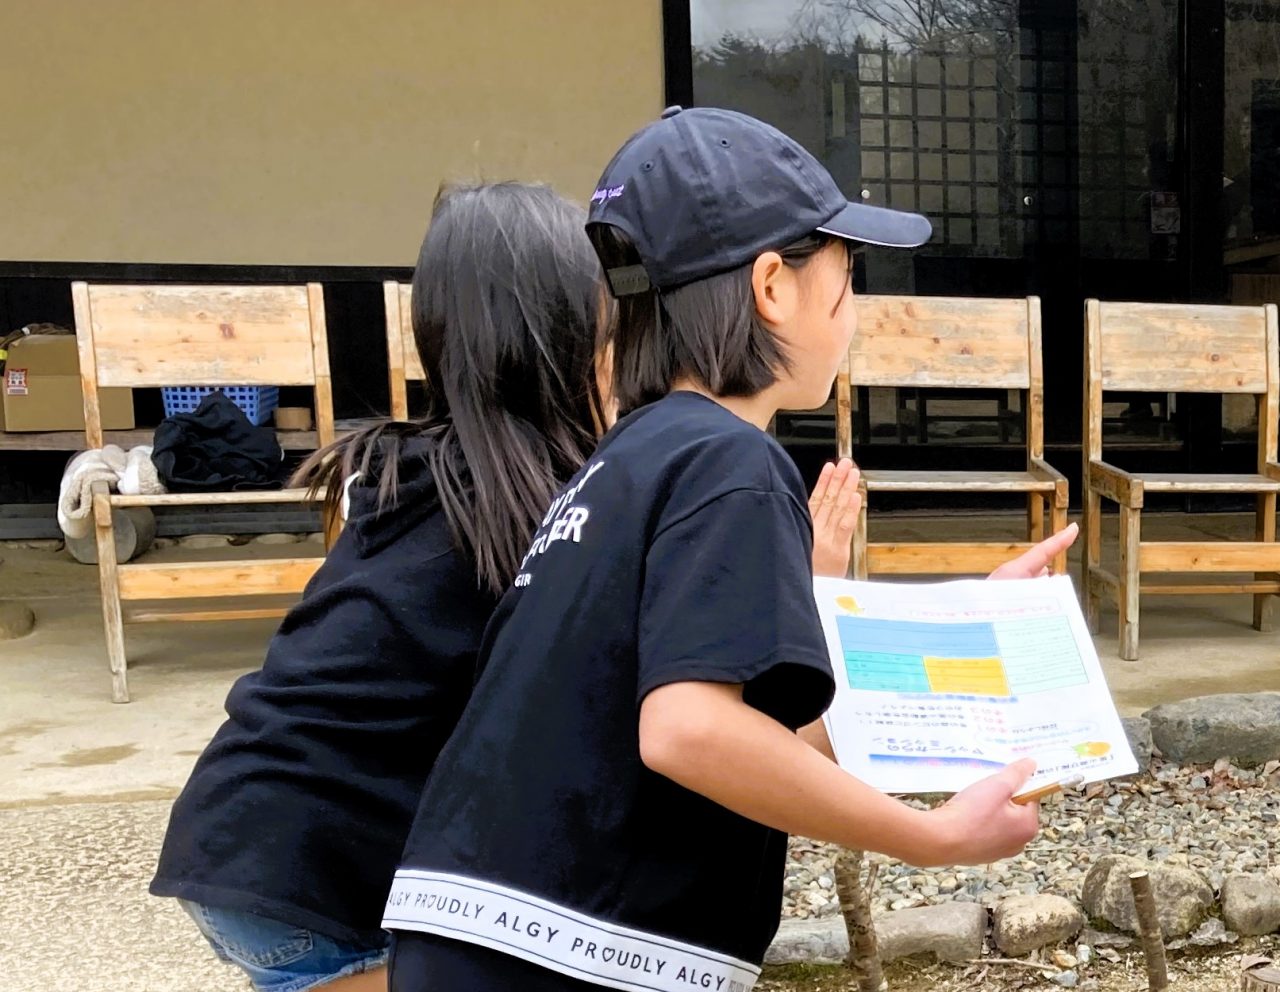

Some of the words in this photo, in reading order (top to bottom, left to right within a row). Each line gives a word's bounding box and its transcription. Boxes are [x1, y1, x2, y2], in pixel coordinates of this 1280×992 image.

[389, 891, 411, 908] ALGY
[494, 911, 560, 944] ALGY
[676, 966, 727, 992] ALGY
